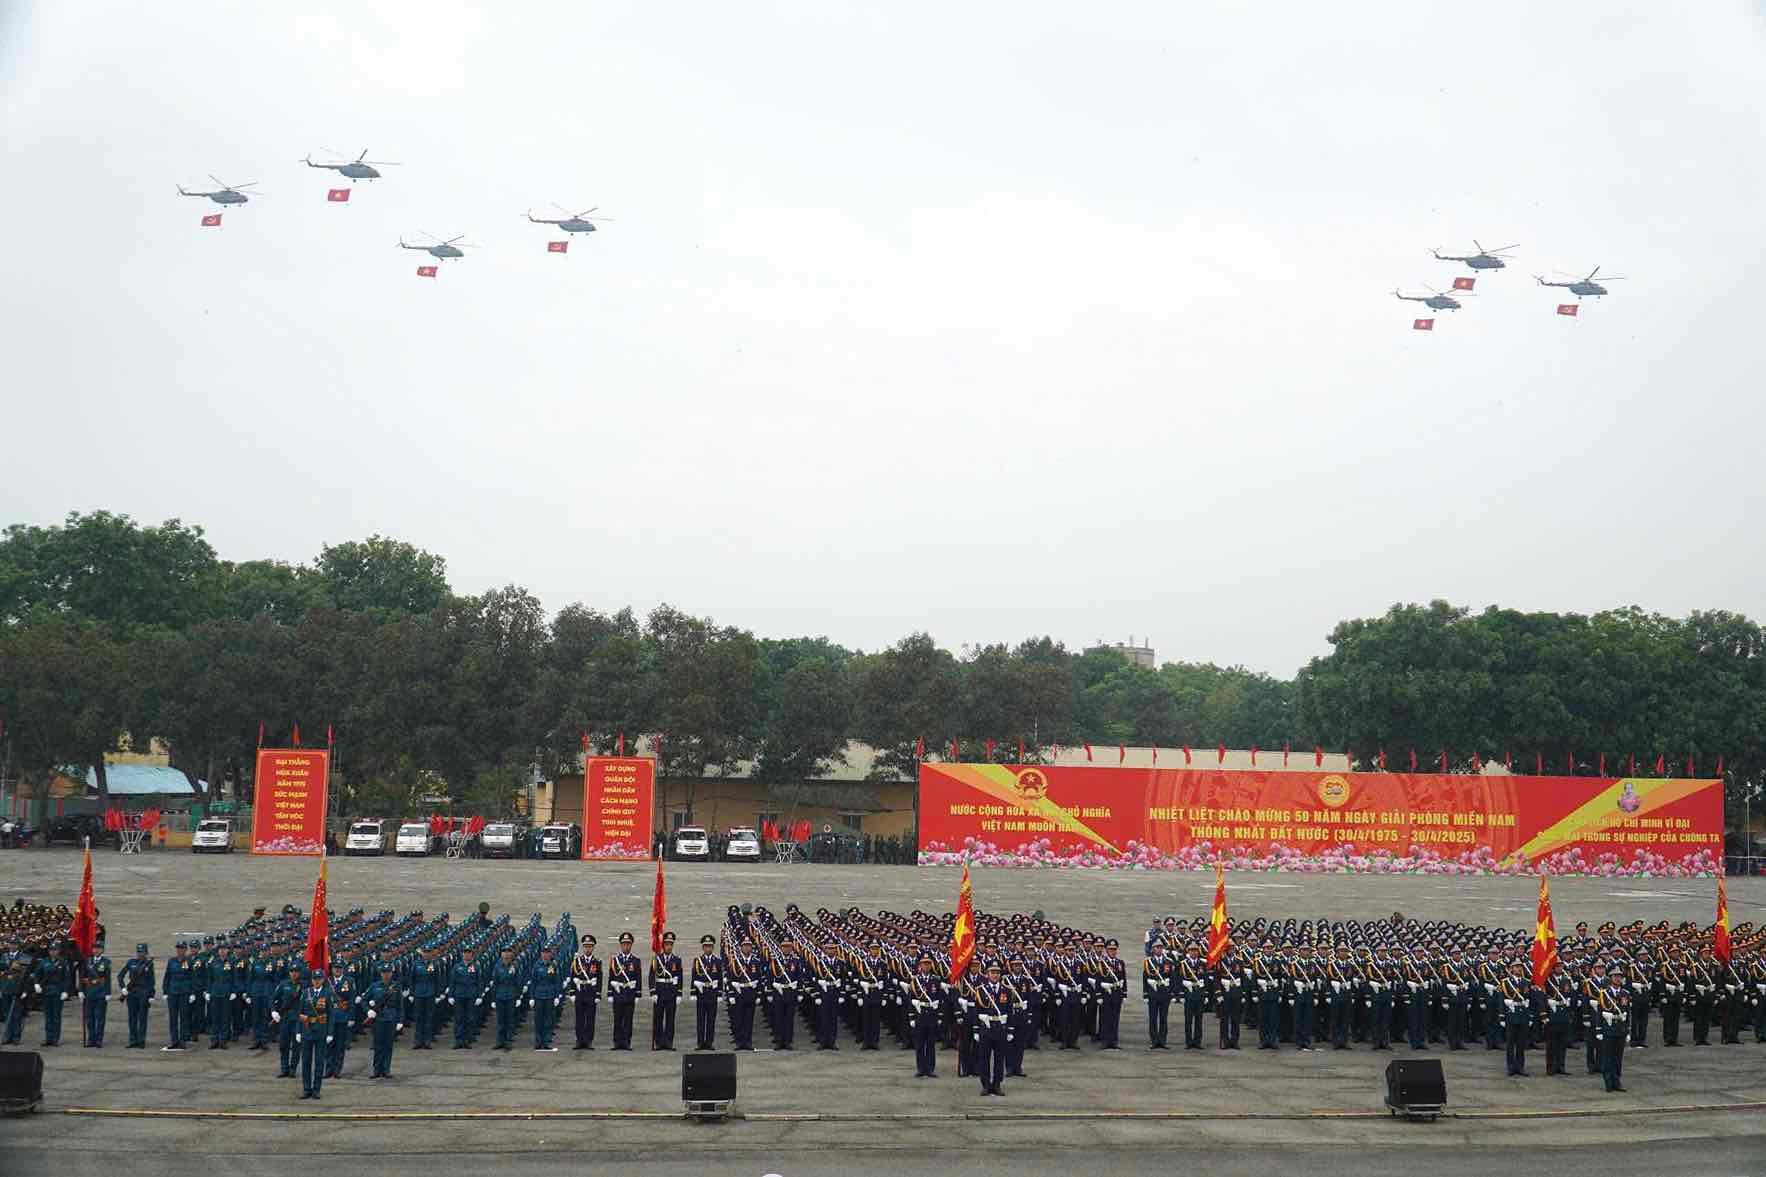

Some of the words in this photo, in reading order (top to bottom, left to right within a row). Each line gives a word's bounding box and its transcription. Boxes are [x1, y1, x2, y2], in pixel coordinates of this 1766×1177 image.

[950, 803, 976, 816] NƯỚC
[978, 803, 1004, 818] CỘNG
[1062, 804, 1080, 817] CHỦ
[1082, 804, 1112, 818] NGHĨA
[1150, 806, 1184, 823] NHIỆT
[1188, 806, 1213, 823] LIỆT
[1219, 808, 1250, 822] CHÀO
[1256, 807, 1290, 823] MỪNG
[1296, 810, 1309, 822] 50
[1314, 808, 1340, 824] NĂM
[1345, 808, 1377, 824] NGÀY
[1381, 808, 1406, 824] GIẢI
[1410, 808, 1450, 826] PHÓNG
[1453, 810, 1484, 826] MIỀN
[1488, 814, 1516, 826] NAM
[982, 819, 1001, 833] VIỆT
[1004, 821, 1026, 832] NAM
[1028, 819, 1056, 832] MUÔN
[1624, 816, 1638, 828] CHÍ
[1641, 818, 1663, 828] MINH
[1676, 818, 1690, 830] ĐẠI
[1190, 822, 1230, 838] THỐNG
[1234, 824, 1266, 840] NHẤT
[1270, 824, 1292, 840] ĐẤT
[1296, 826, 1329, 840] NƯỚC
[1334, 828, 1399, 842] (30/4/1975
[1411, 830, 1476, 844] 30/4/2025)
[1584, 831, 1612, 842] TRONG
[1614, 831, 1625, 844] SỰ
[1627, 830, 1658, 844] NGHIỆP
[1660, 830, 1677, 842] CỦA
[1679, 830, 1708, 843] CHÚNG
[1710, 833, 1720, 843] TA
